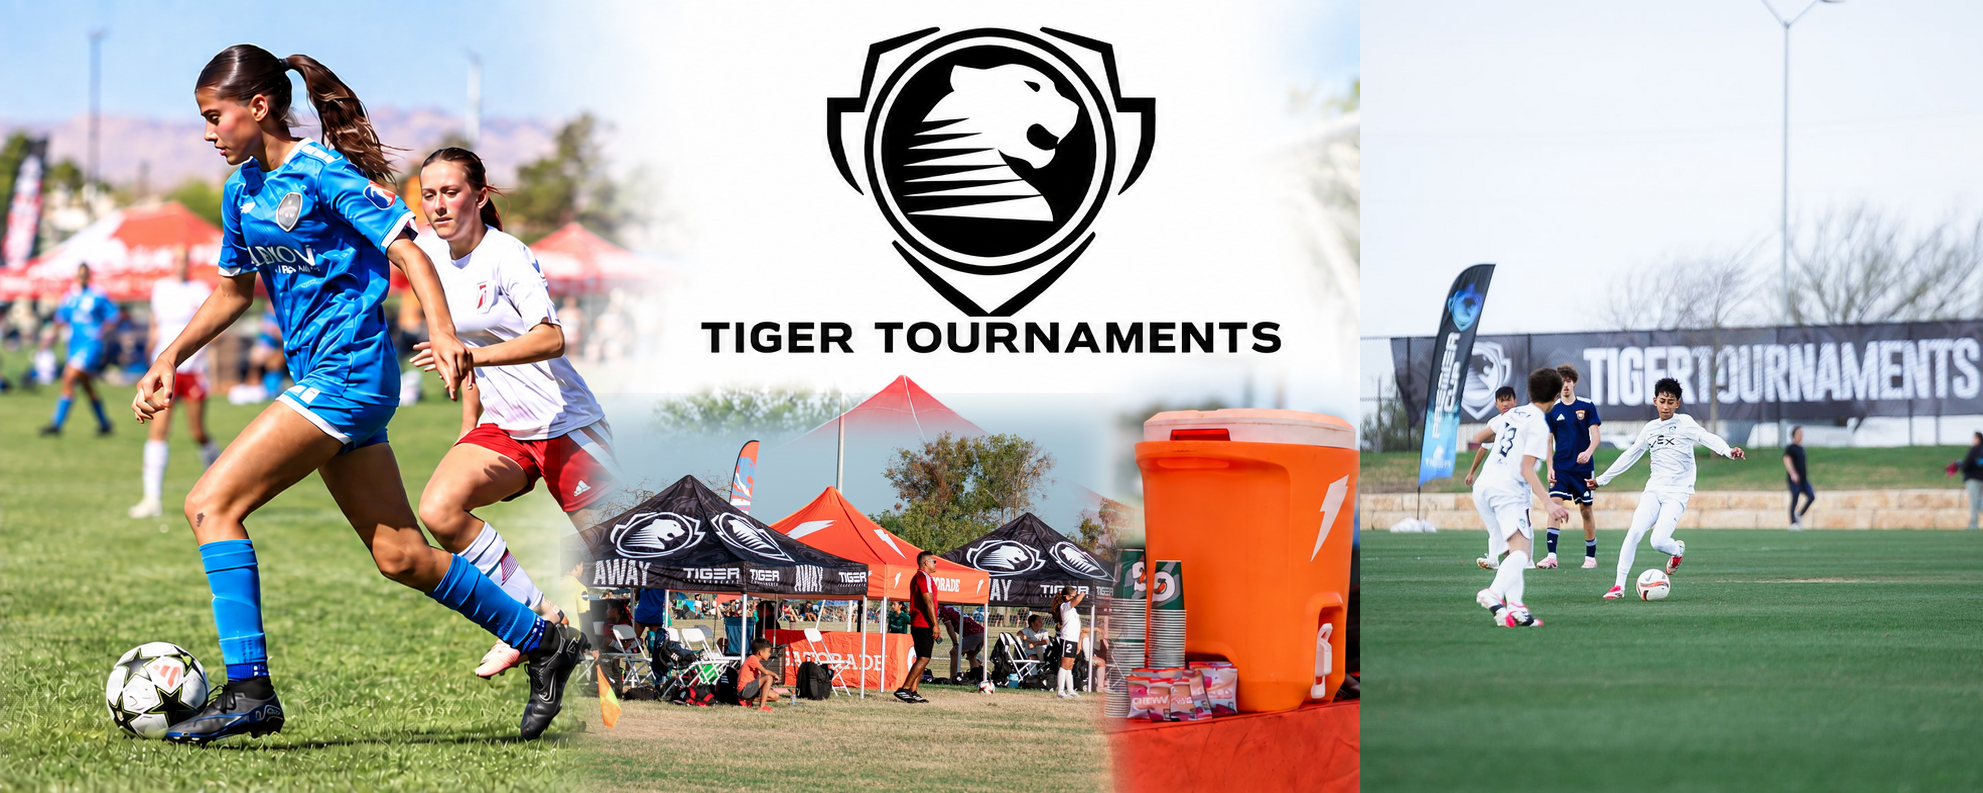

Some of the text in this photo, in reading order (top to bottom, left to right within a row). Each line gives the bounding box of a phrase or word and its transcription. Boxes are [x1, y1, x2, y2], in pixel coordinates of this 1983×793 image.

[593, 558, 650, 586] AWAY
[682, 567, 740, 580] TIGER
[749, 568, 780, 582] TIGER
[794, 564, 823, 592] AWAY
[838, 571, 867, 583] TIGER
[1065, 643, 1073, 654] 2
